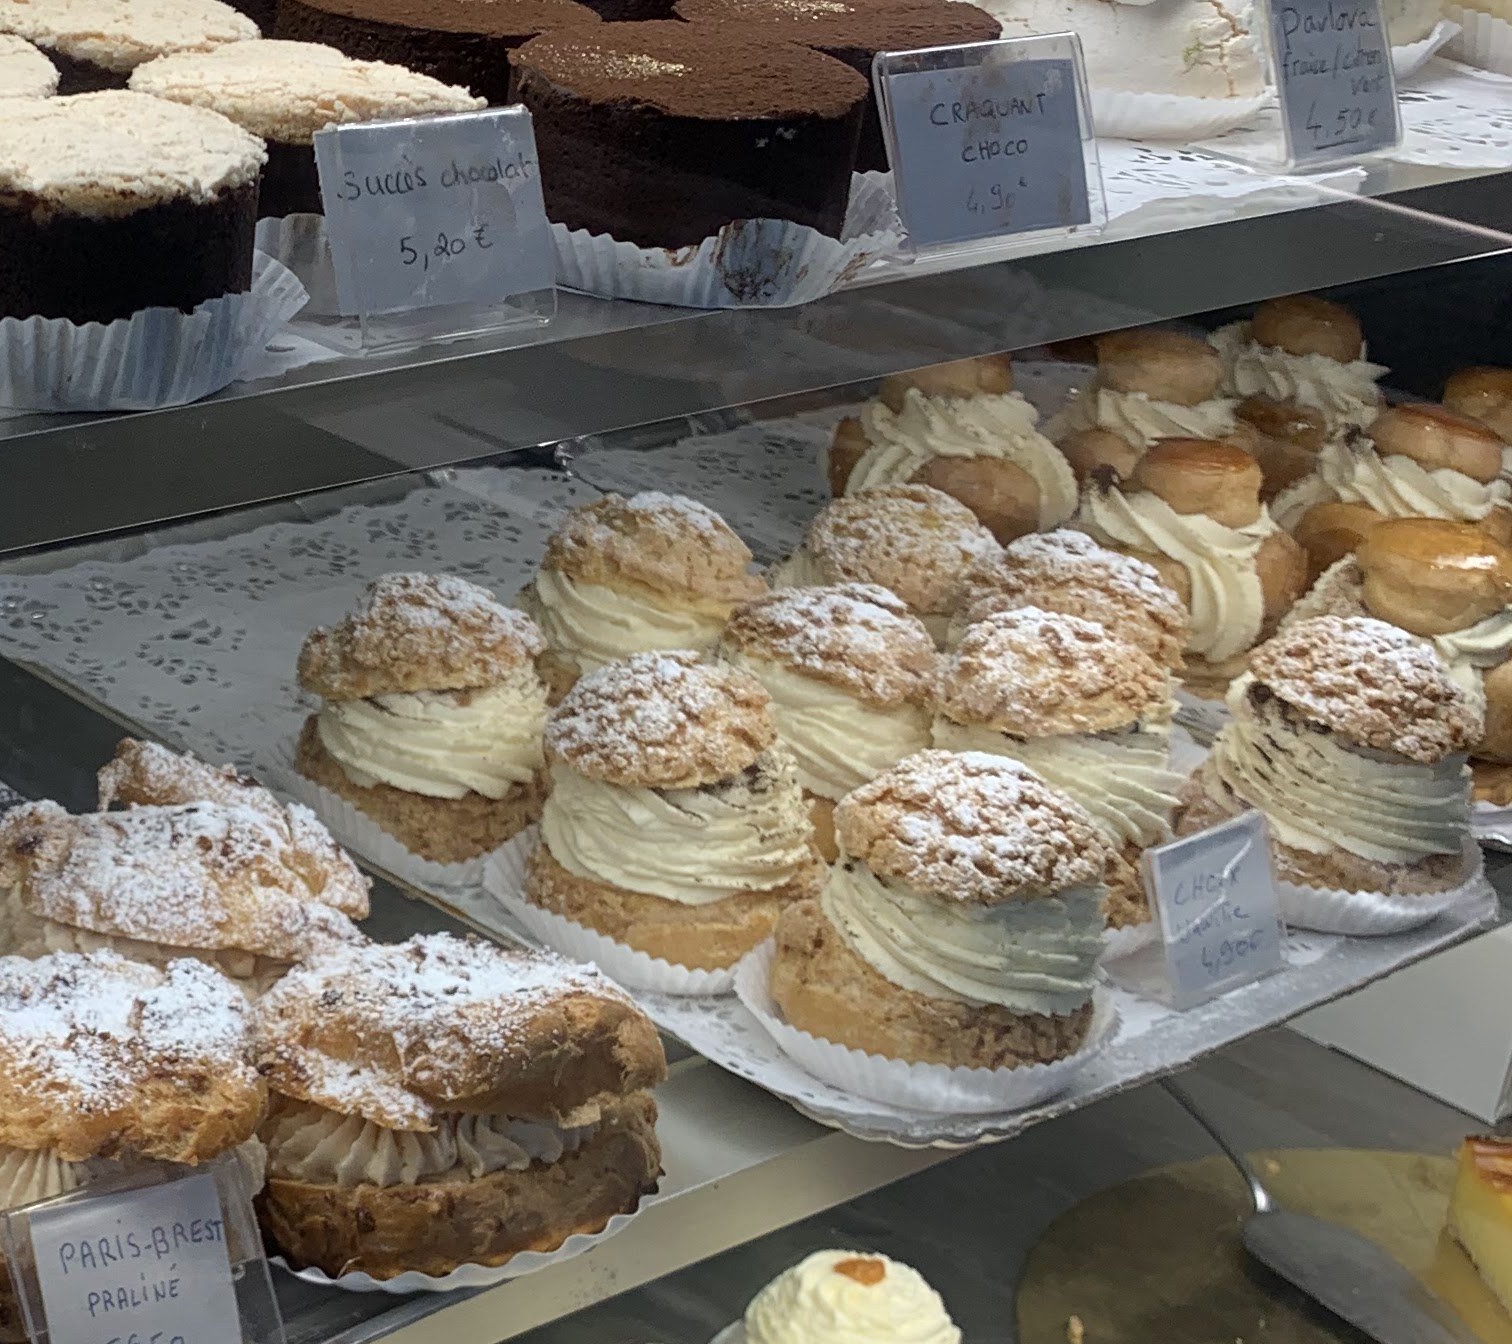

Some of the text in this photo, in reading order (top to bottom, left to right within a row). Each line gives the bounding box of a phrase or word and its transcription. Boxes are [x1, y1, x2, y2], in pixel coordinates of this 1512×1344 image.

[1282, 2, 1375, 49] Pavlova
[929, 93, 1046, 126] CRAQUANT
[960, 139, 1029, 163] CHOCO
[337, 151, 538, 201] Succès chocolat
[58, 1218, 224, 1275] PARIS-BREST
